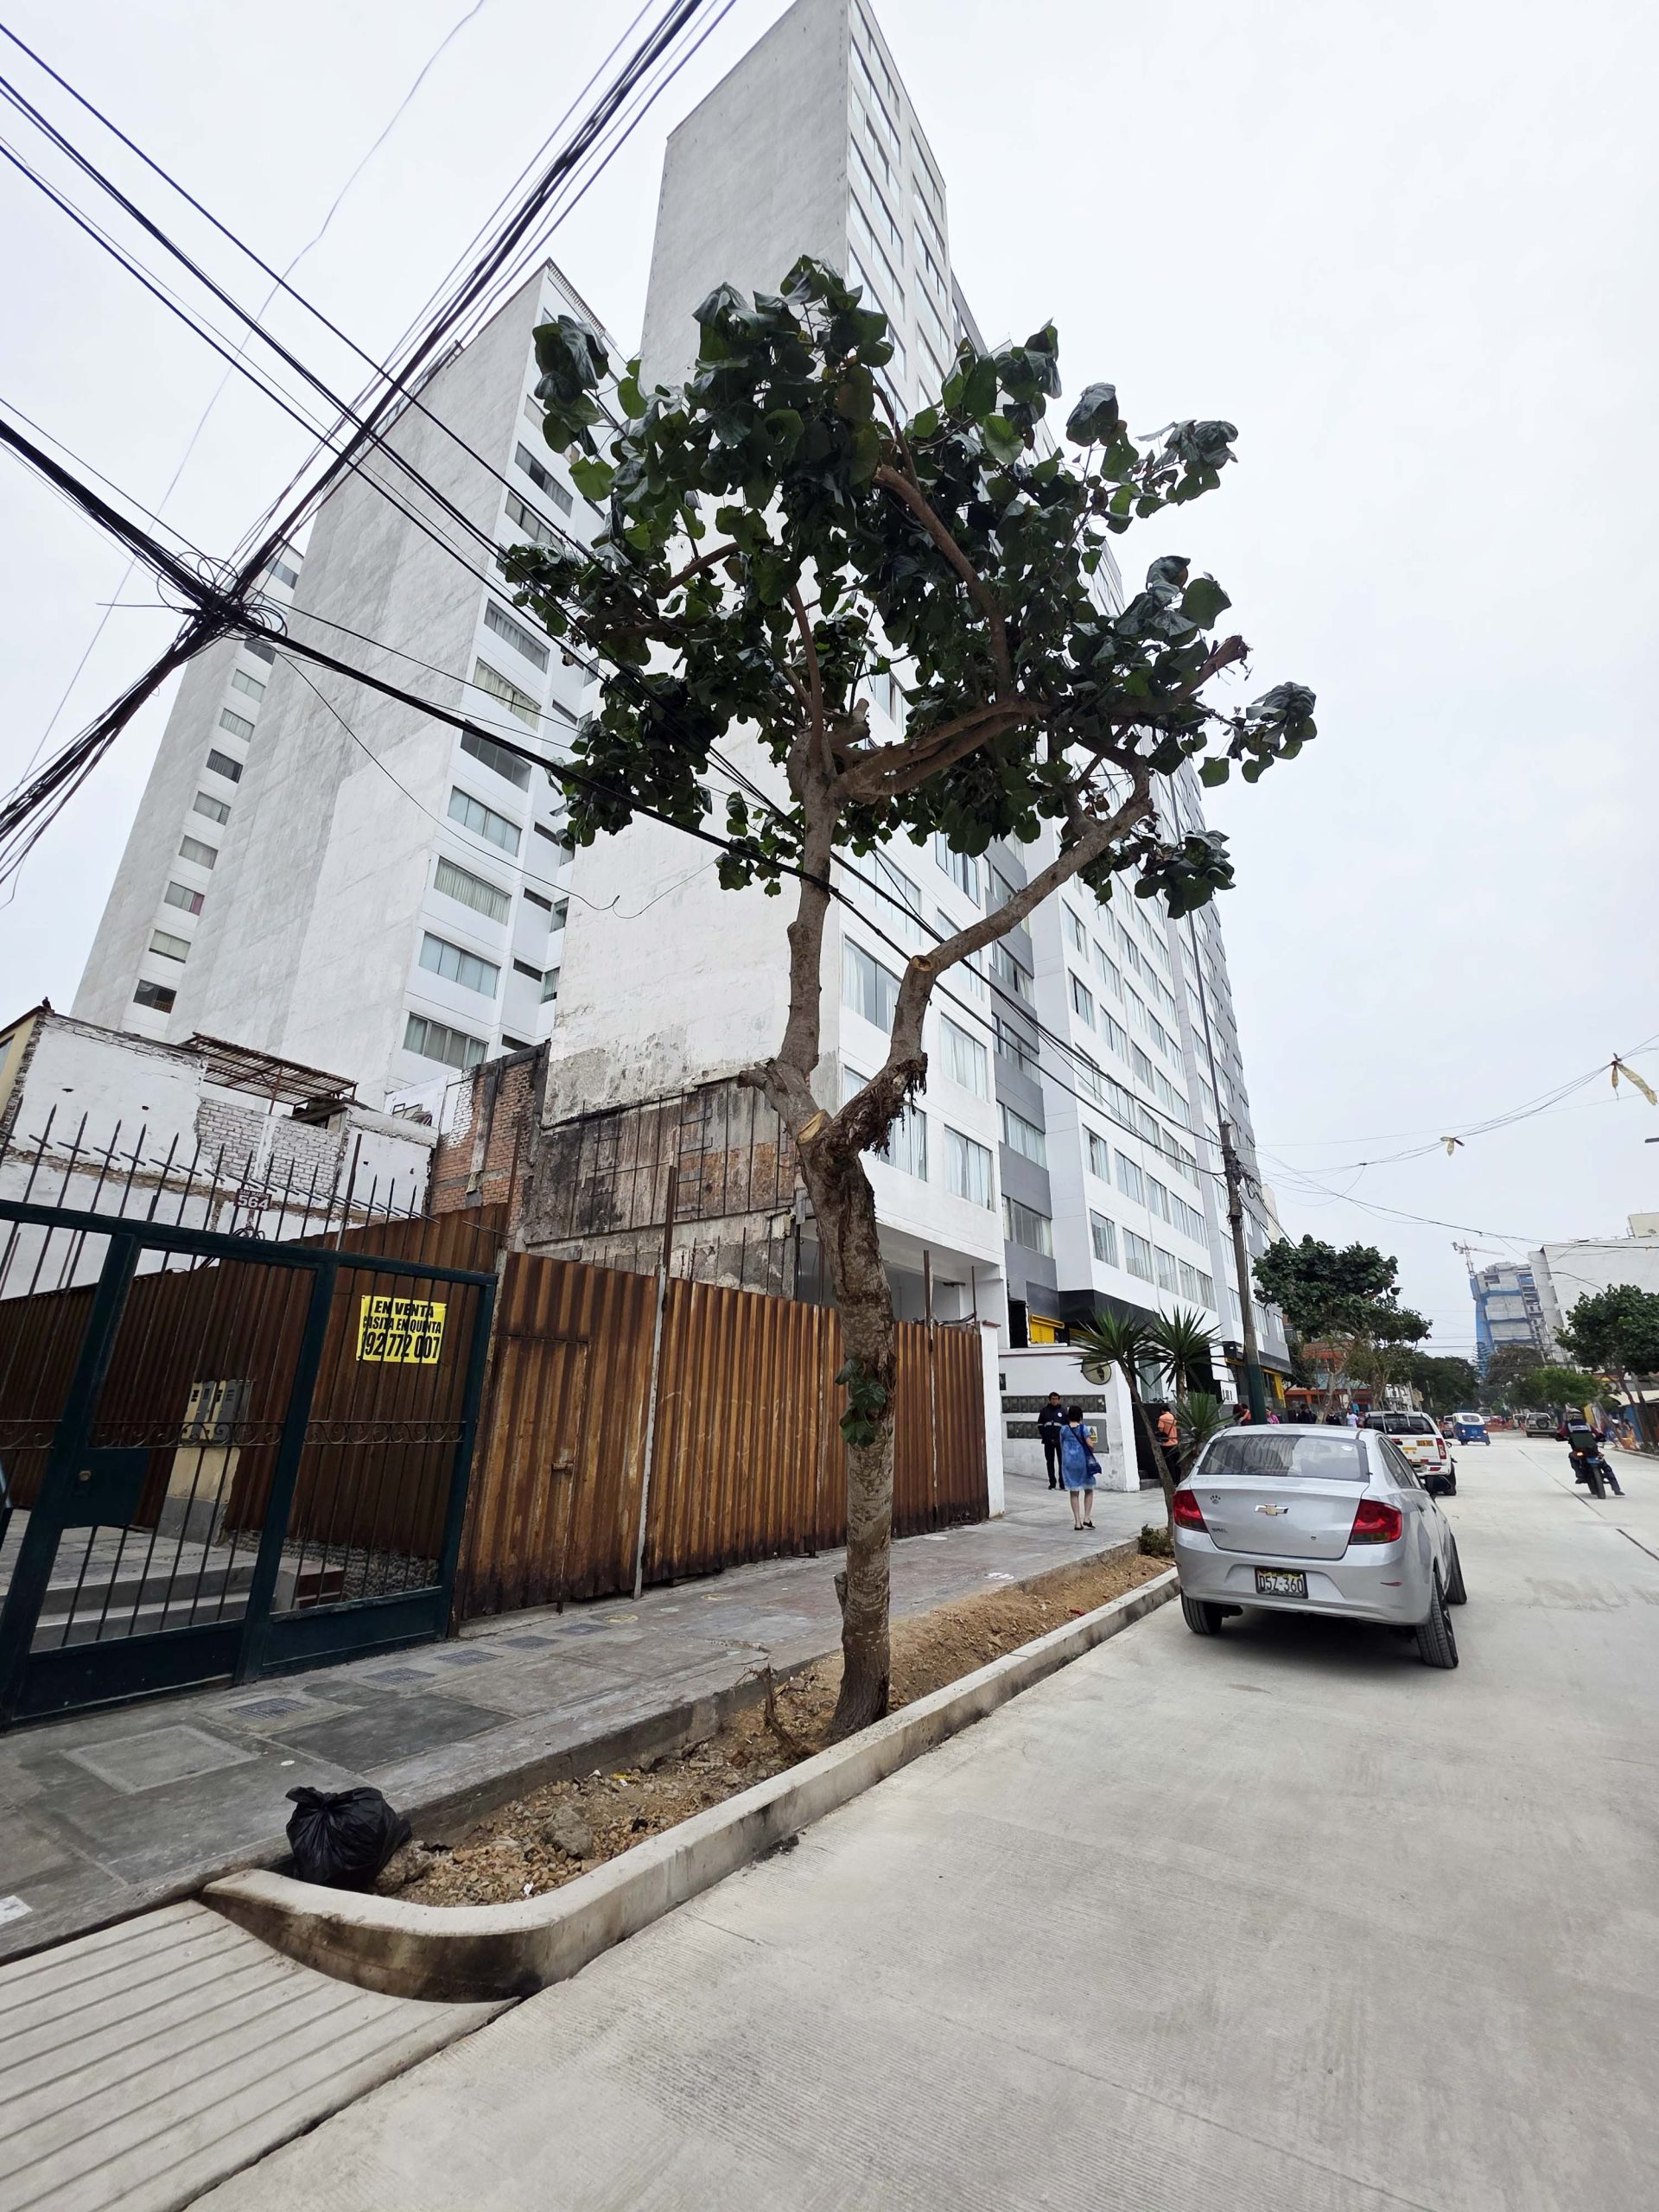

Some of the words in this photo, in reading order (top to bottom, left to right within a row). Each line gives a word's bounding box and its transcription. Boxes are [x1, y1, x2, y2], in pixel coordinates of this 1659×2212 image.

[238, 1194, 269, 1210] 564
[374, 1300, 391, 1314] EN
[395, 1302, 434, 1318] VENTA
[397, 1318, 409, 1332] EN
[1259, 1575, 1304, 1593] D5Z-360
